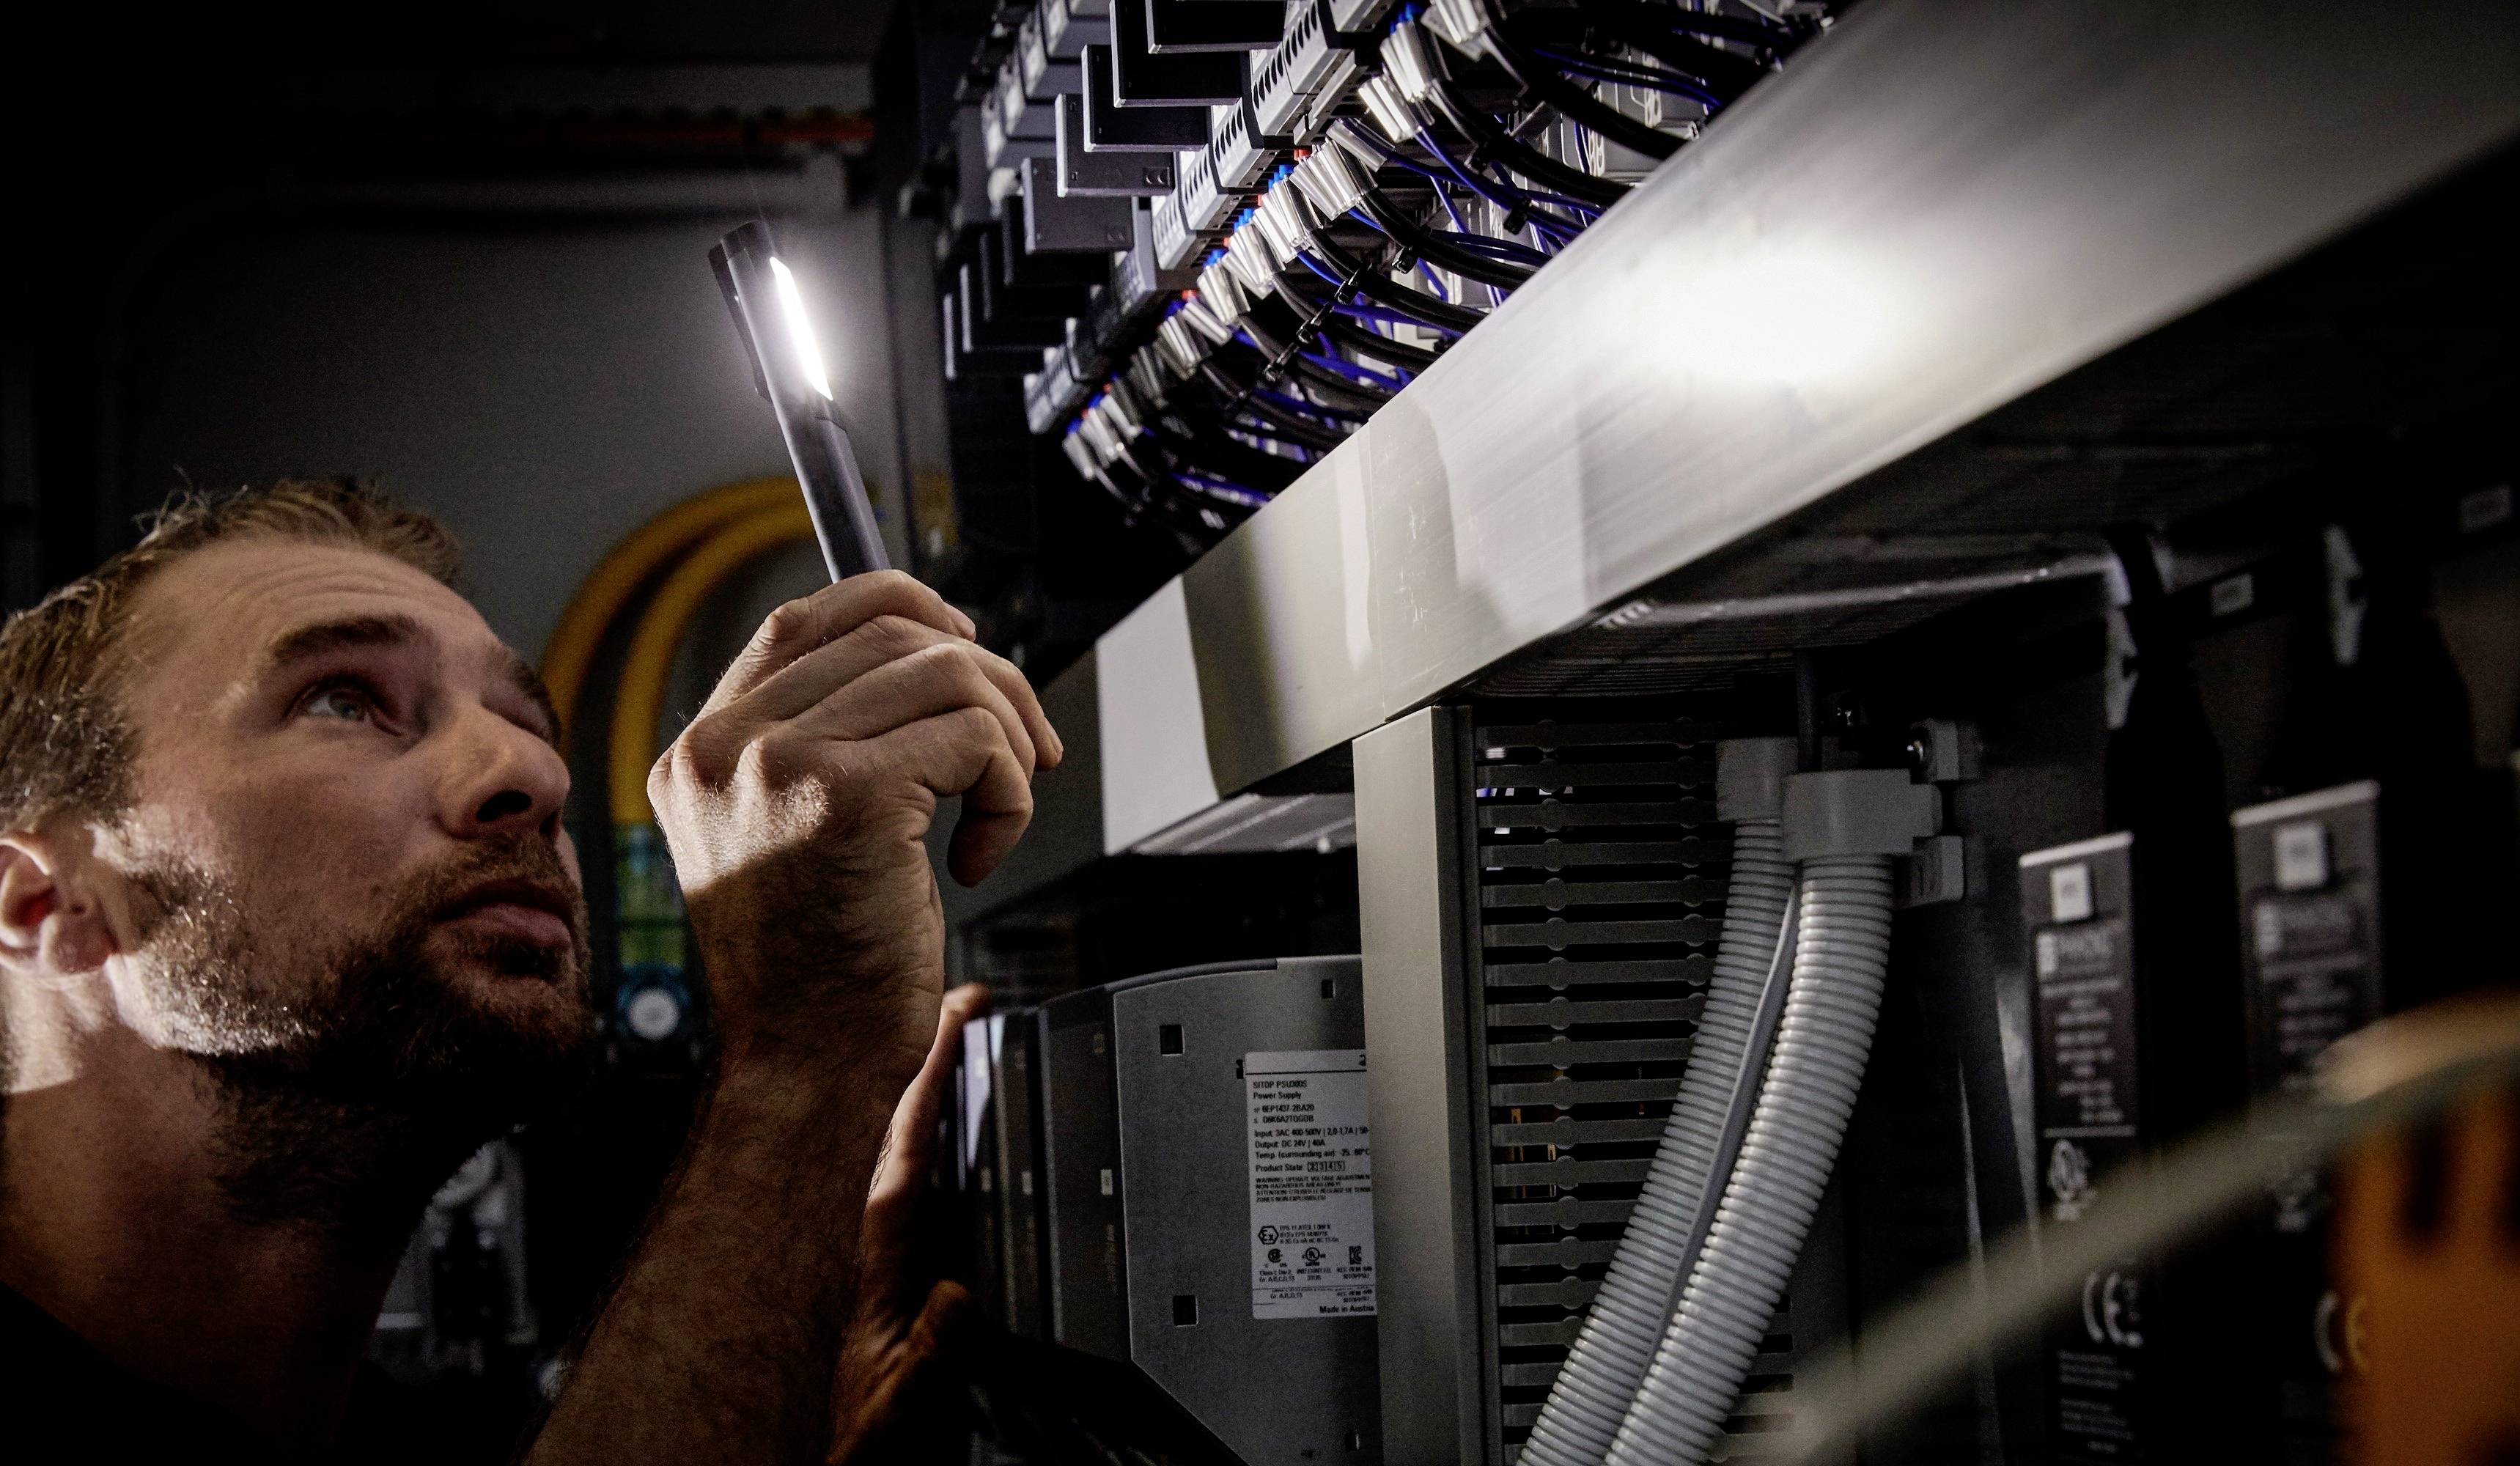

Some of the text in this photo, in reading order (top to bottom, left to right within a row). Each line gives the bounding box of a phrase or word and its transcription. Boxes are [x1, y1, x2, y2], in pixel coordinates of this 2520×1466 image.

[1253, 1080, 1275, 1089] SITOP
[1253, 1091, 1302, 1100] Power Supply
[1275, 1129, 1290, 1137] 3AC
[1281, 1140, 1292, 1148] DC
[1294, 1139, 1307, 1147] 24V
[1312, 1138, 1325, 1146] 40A
[1278, 1150, 1322, 1159] (surrounding
[1256, 1164, 1283, 1172] Product
[1319, 1305, 1340, 1314] Made
[1349, 1304, 1374, 1313] Austria
